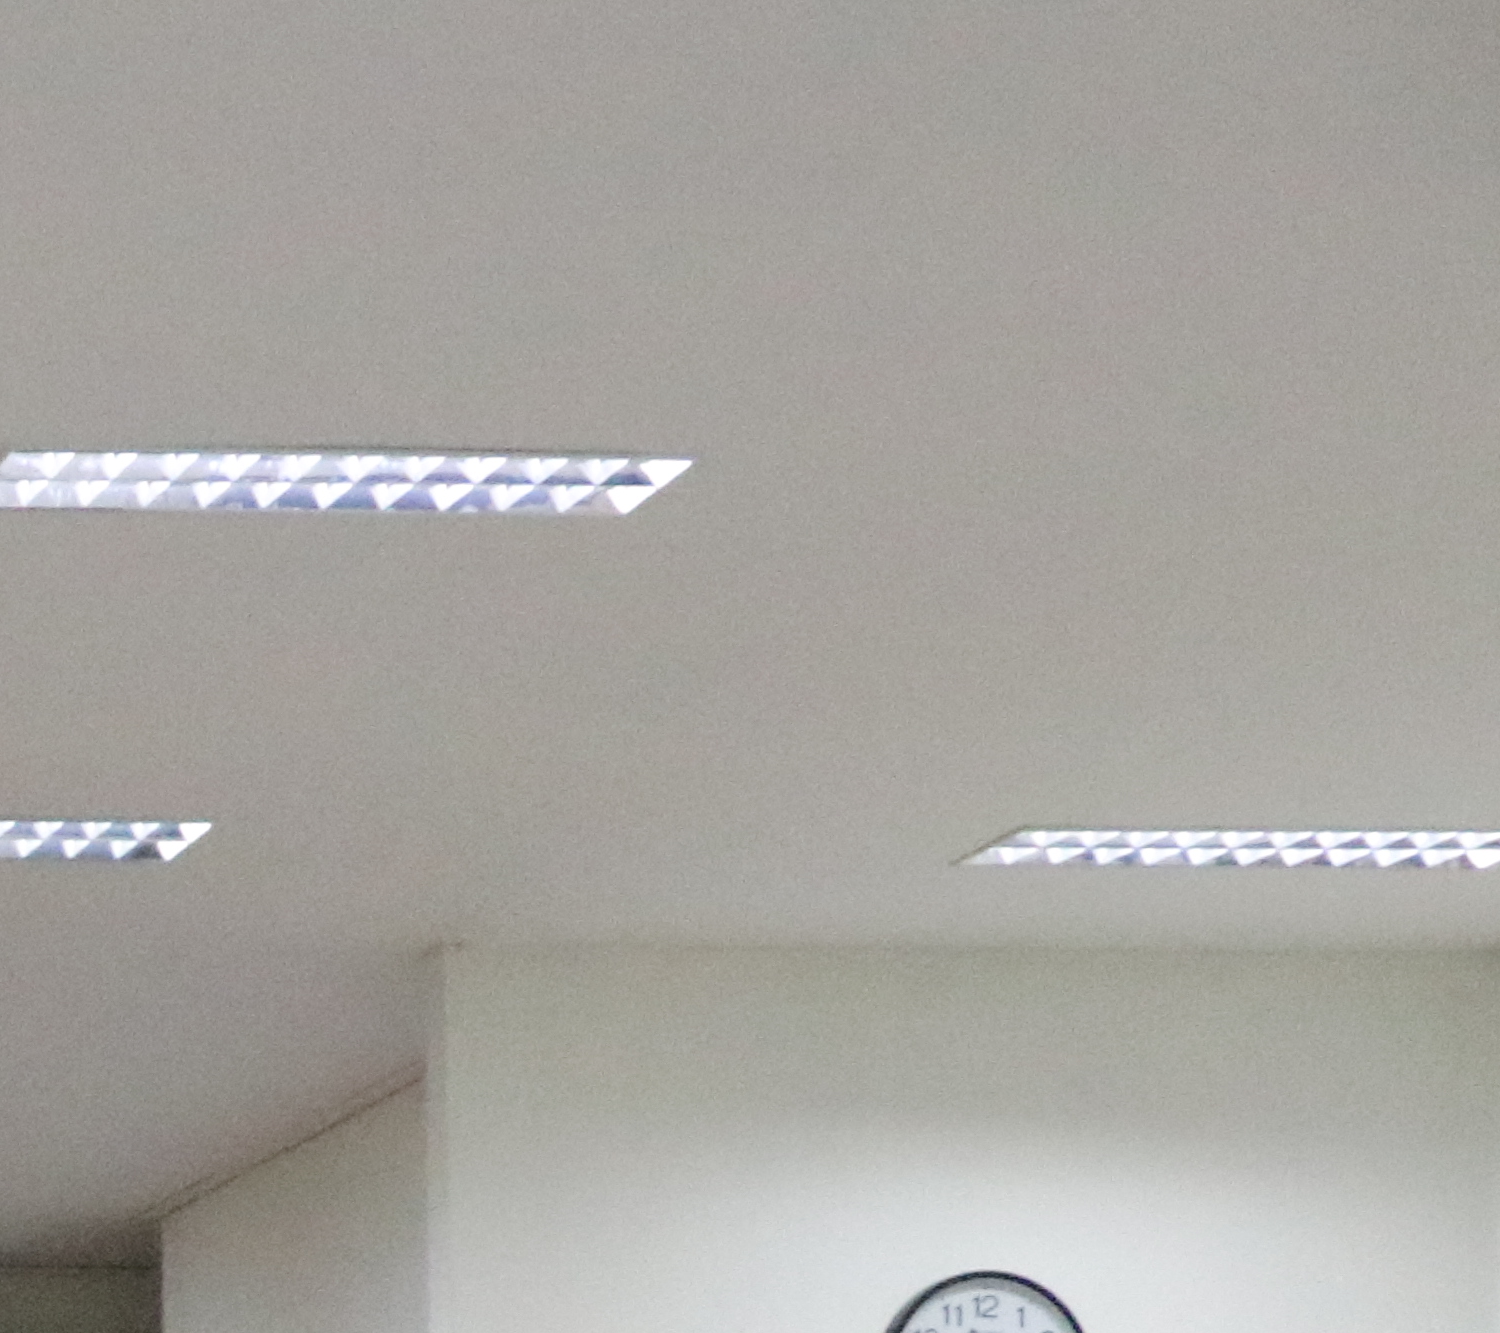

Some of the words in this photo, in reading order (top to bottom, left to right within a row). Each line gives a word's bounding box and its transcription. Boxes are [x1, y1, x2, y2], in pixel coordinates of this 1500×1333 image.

[943, 1304, 963, 1327] 11
[972, 1294, 998, 1318] 12
[1016, 1306, 1025, 1328] 1
